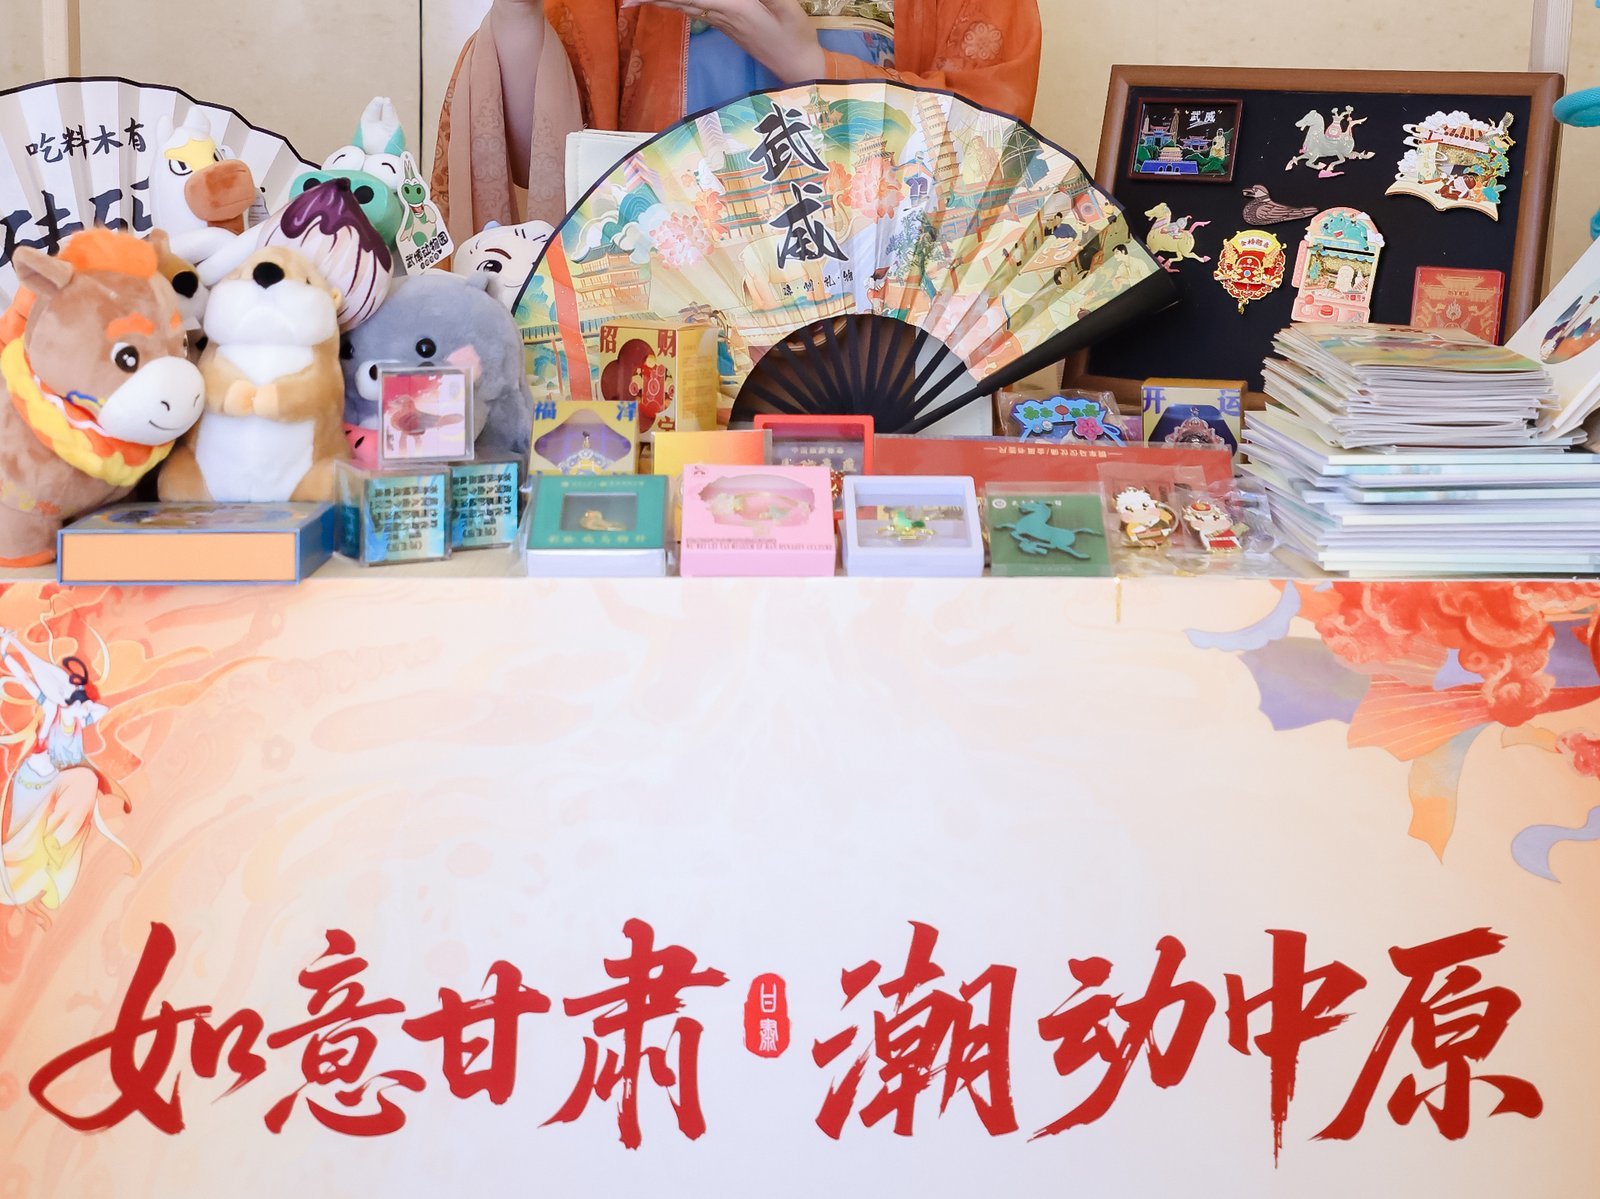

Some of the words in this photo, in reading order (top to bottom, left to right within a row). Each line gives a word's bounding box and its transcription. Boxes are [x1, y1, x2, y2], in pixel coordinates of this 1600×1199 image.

[25, 117, 146, 163] 吃料木有
[749, 102, 849, 270] 武威
[28, 918, 730, 1150] 如意甘肃
[812, 920, 1544, 1169] 潮动中原
